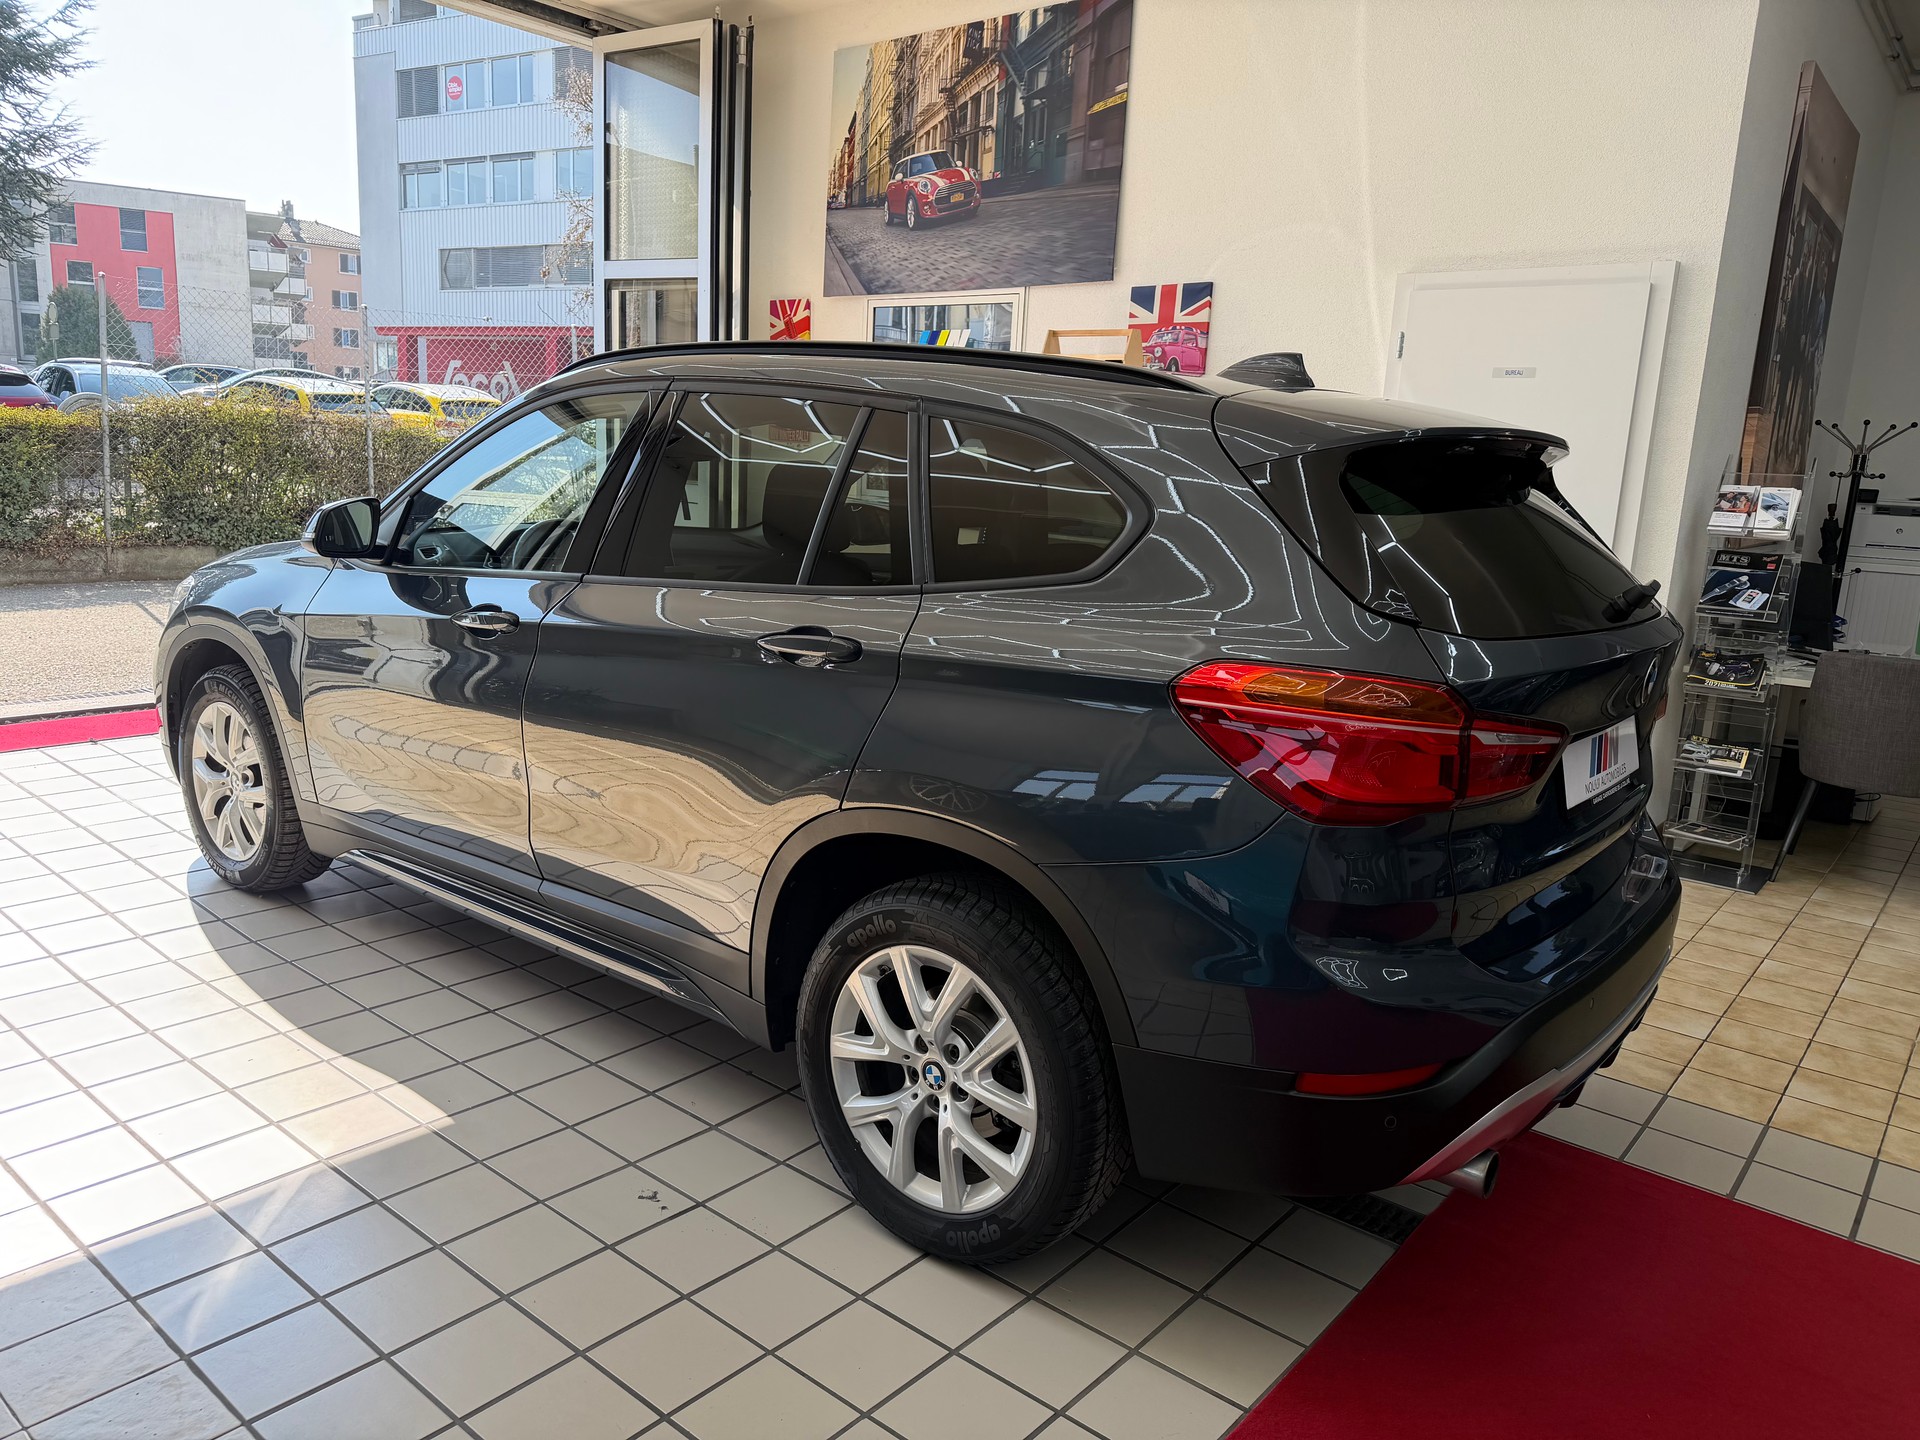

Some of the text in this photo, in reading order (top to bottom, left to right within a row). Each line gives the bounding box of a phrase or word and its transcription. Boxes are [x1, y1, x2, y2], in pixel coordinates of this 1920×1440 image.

[1718, 553, 1750, 563] MTS
[219, 683, 253, 723] MICHELIN
[846, 914, 897, 947] apollo
[945, 1220, 1001, 1254] apollo
